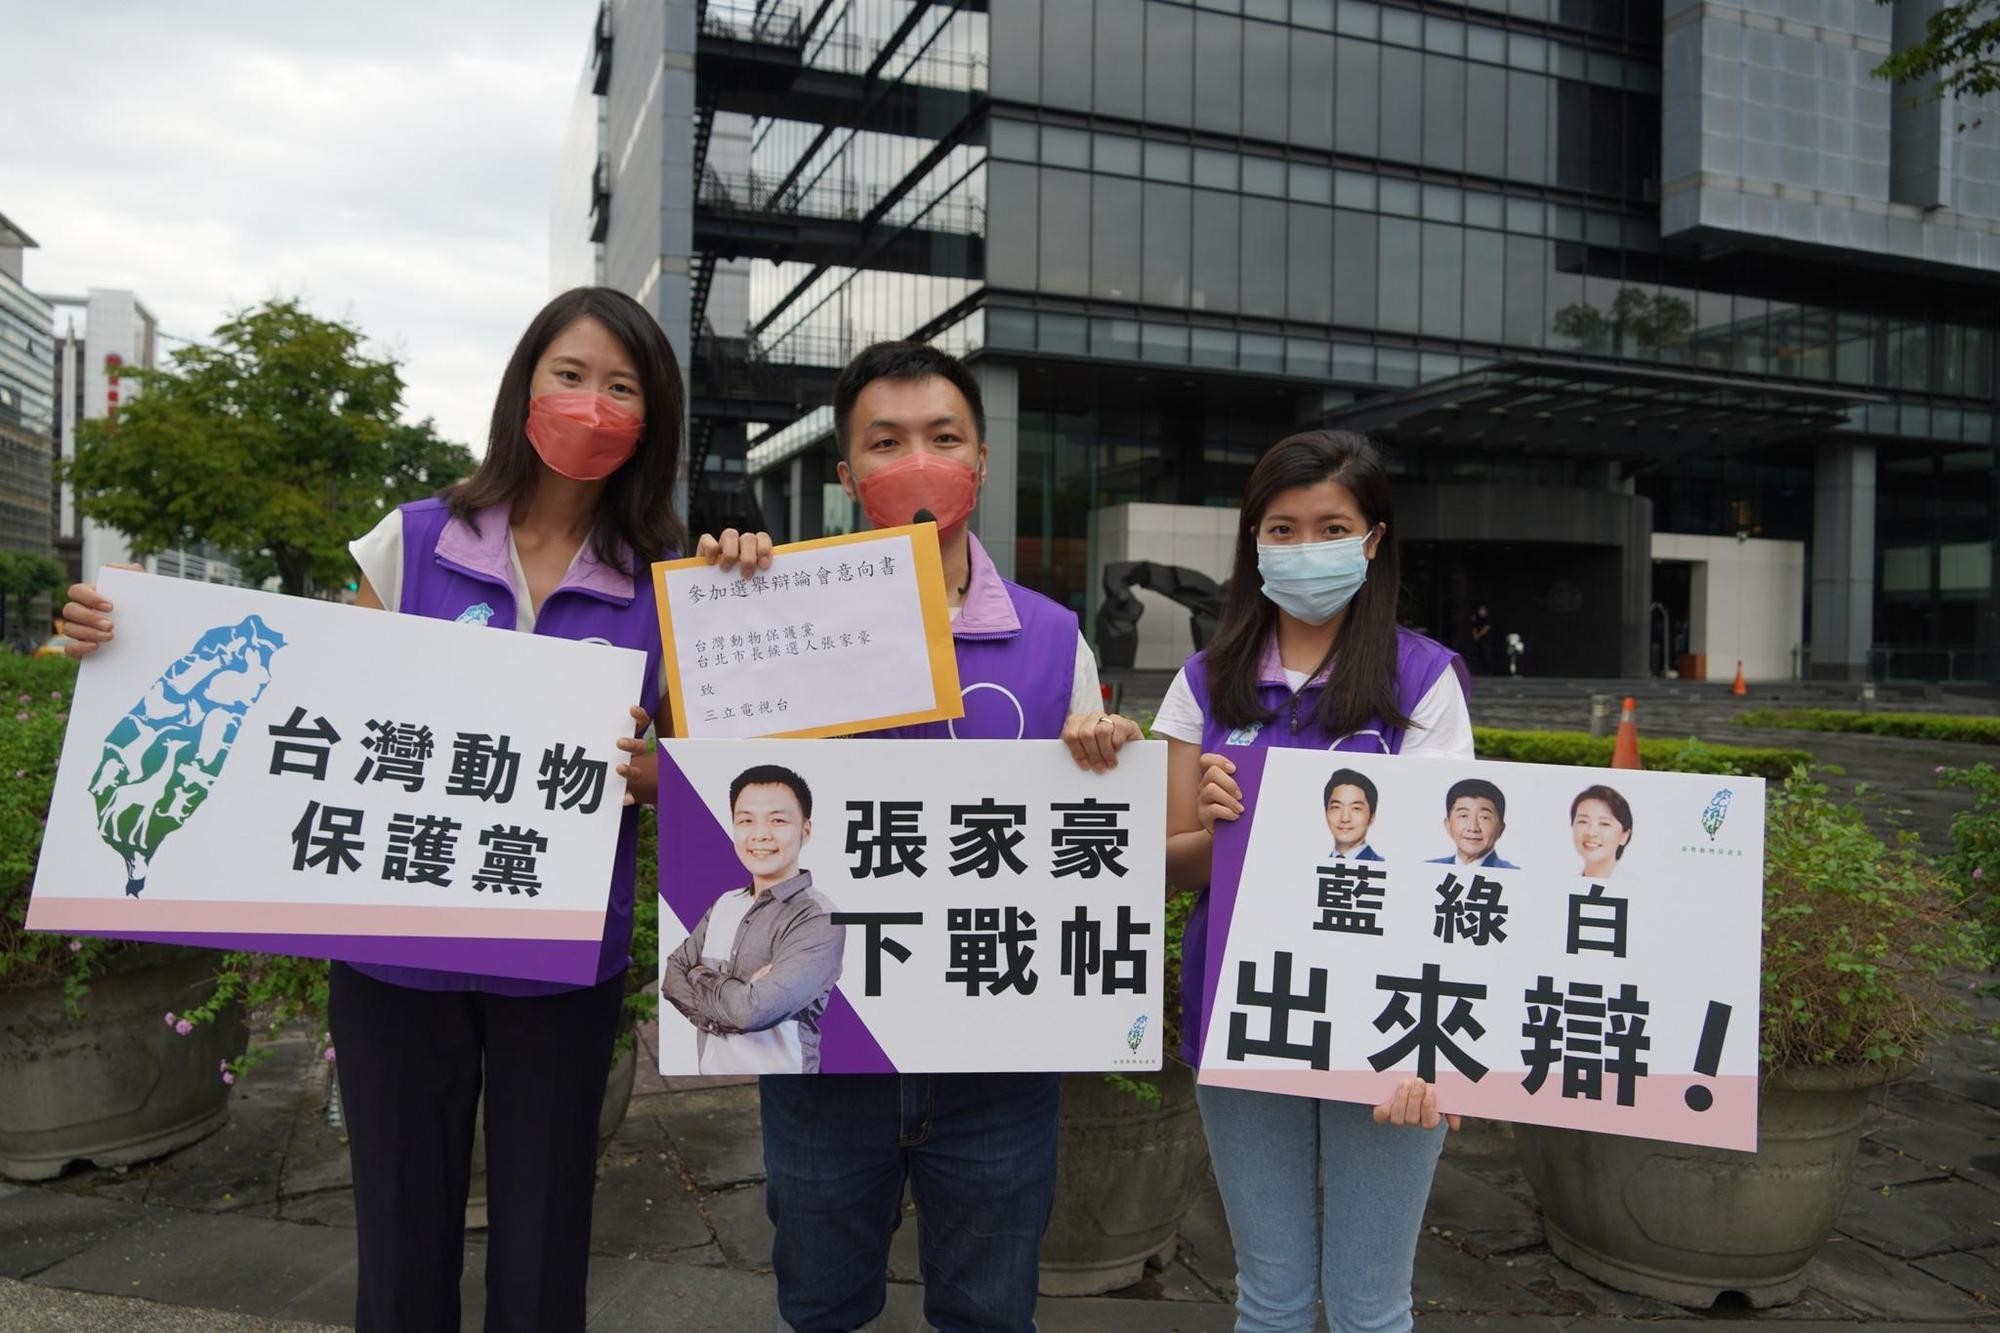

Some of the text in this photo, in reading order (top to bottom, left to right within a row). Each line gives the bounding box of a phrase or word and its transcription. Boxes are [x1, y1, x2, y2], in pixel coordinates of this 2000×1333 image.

[688, 556, 896, 605] 參加選舉辯論會意向書
[700, 683, 716, 697] 致
[704, 698, 789, 722] 三立電視台
[268, 706, 608, 815] 台灣動物
[292, 800, 549, 898] 保護黨
[845, 798, 1130, 879] 張家豪
[830, 906, 1151, 997] 下戰帖
